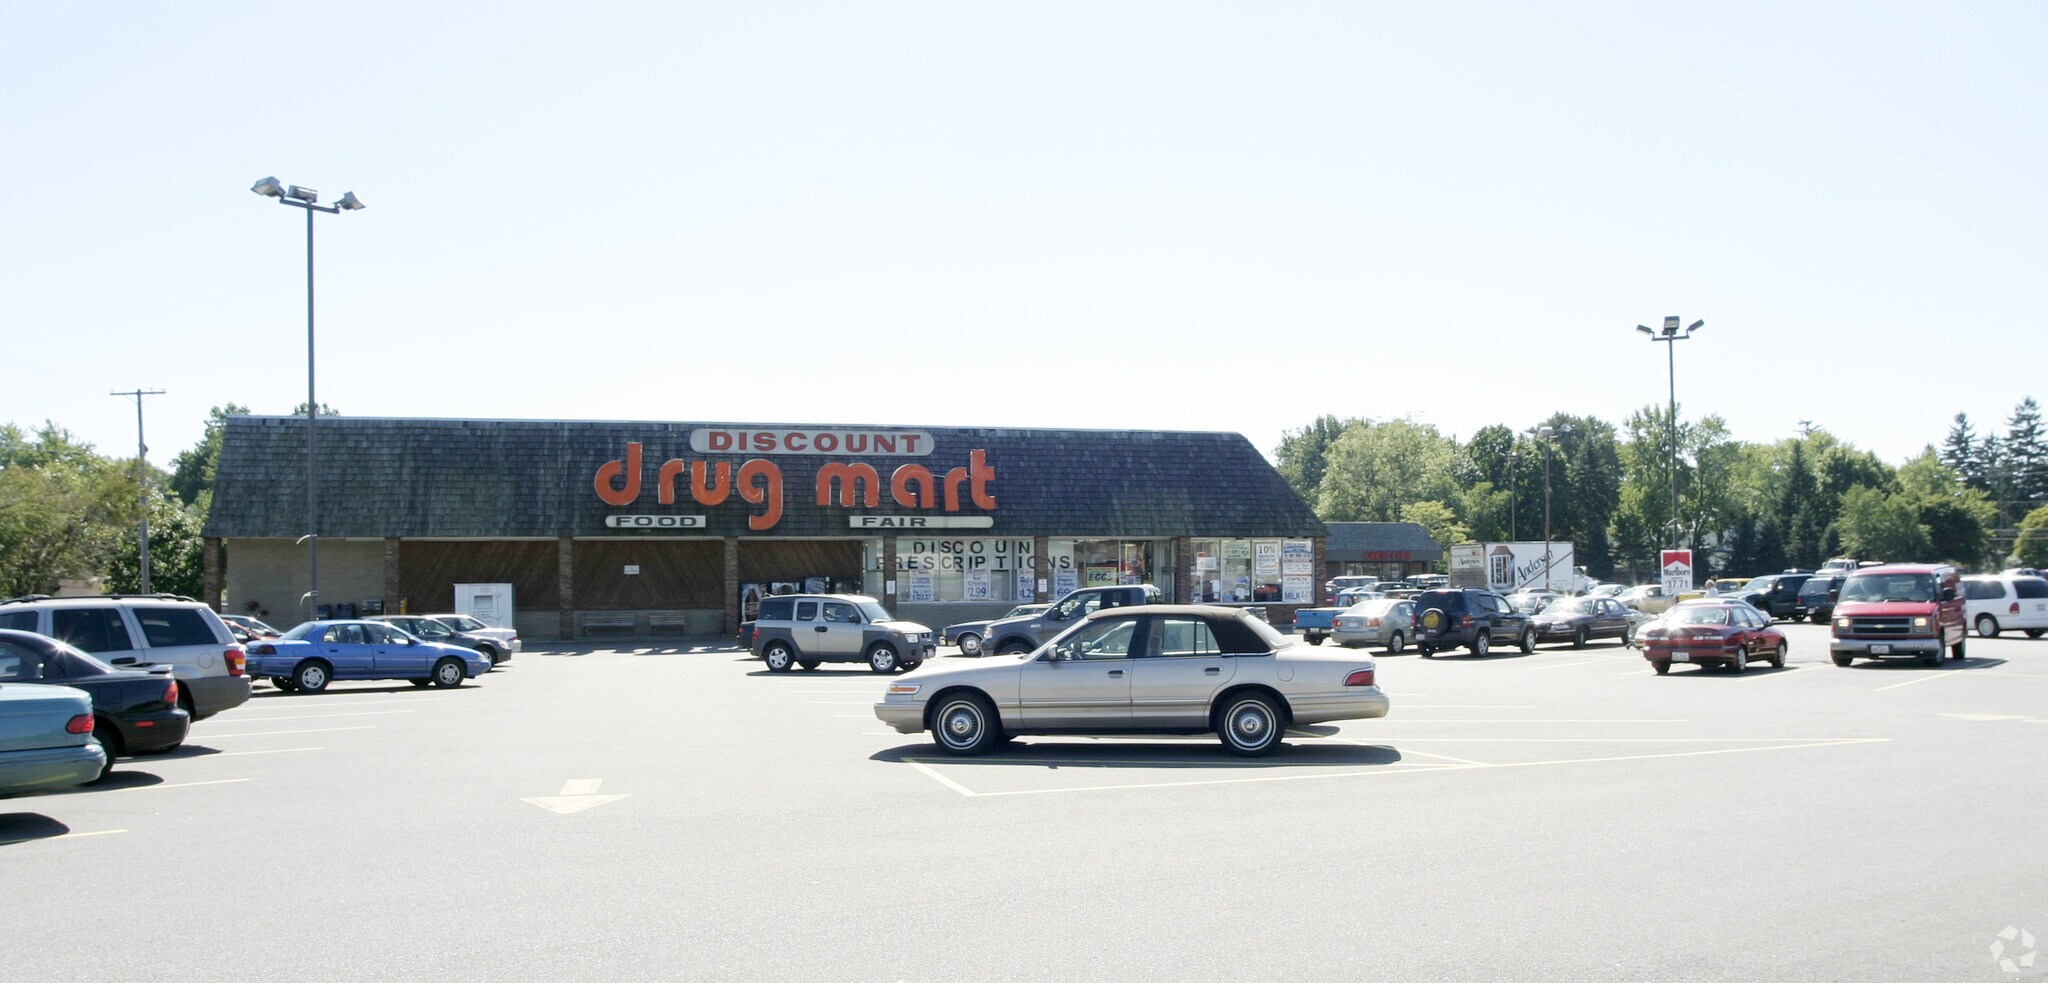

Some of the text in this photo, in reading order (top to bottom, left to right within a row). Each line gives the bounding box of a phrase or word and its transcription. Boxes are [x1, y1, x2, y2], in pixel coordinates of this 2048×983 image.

[708, 431, 921, 453] DISCOUNT
[594, 441, 996, 531] drug mart
[615, 516, 698, 527] FOOD
[861, 517, 927, 527] FAIR
[913, 540, 1031, 554] DISCOUN
[1258, 545, 1276, 554] 10%
[1517, 549, 1554, 586] Andersn
[1663, 566, 1691, 575] Marlboro
[1667, 580, 1688, 589] 37.71
[1284, 592, 1301, 600] MILK
